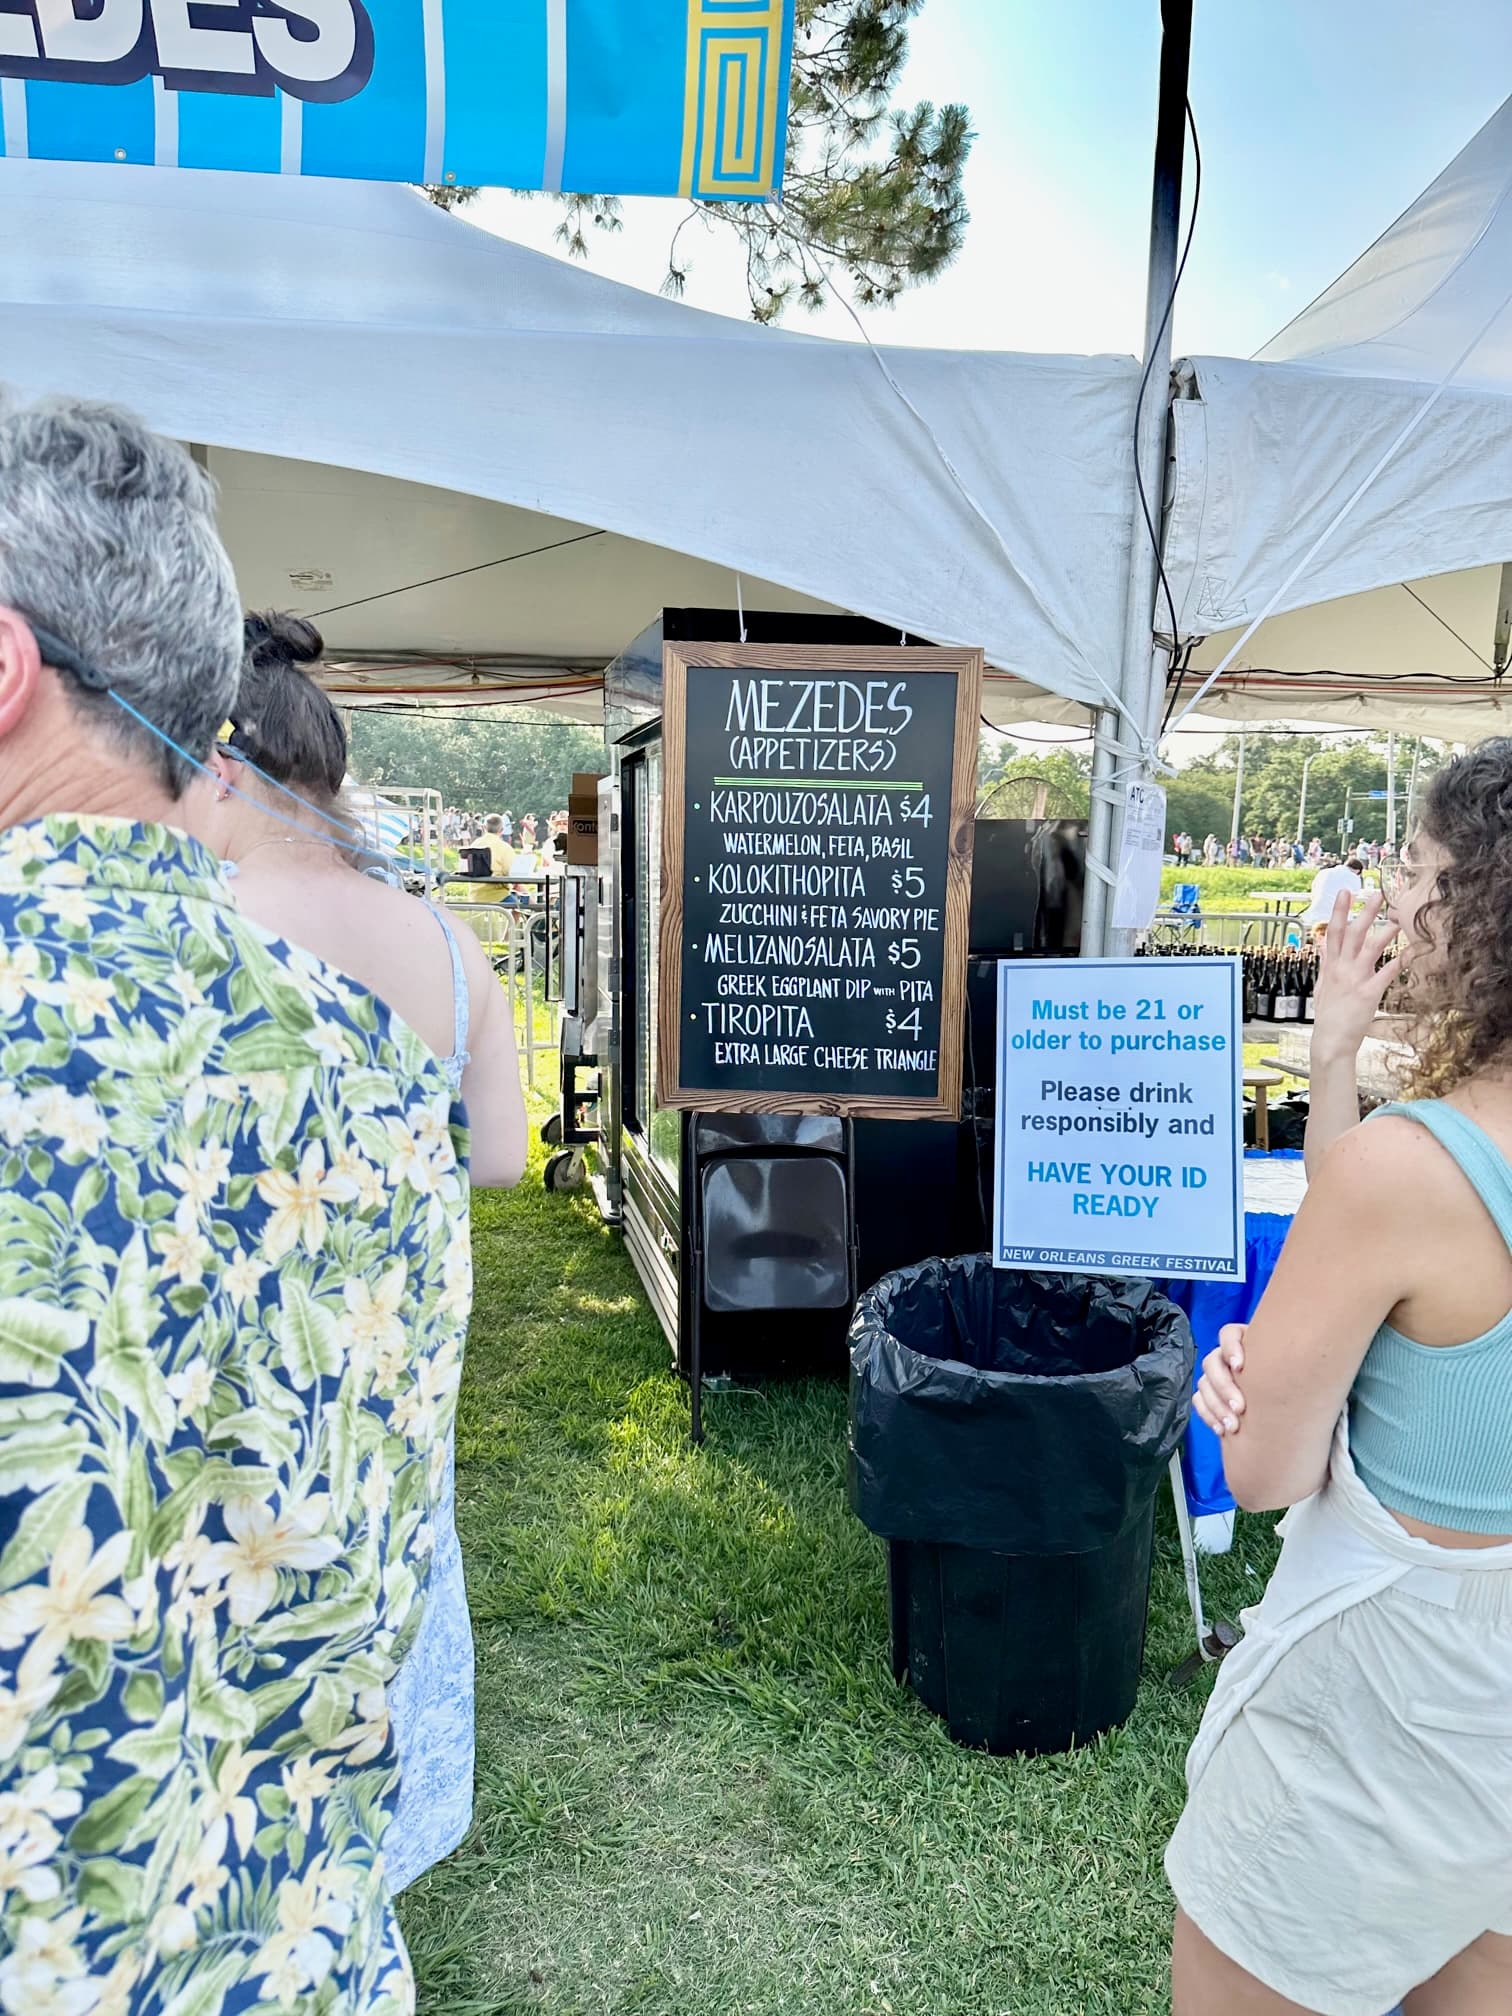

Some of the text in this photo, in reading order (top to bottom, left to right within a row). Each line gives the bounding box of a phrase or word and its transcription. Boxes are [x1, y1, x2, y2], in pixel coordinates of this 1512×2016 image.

[724, 679, 913, 735] MEZEDES
[730, 735, 897, 772] (APPETIZERS)
[710, 791, 933, 828] KARPOUZOSALATA $4
[724, 833, 914, 862] WATERMELON, FETA, BASIL
[708, 864, 926, 898] KOLOKITHOPITA $5
[719, 903, 797, 927] ZUCCHINI
[810, 906, 848, 929] FETA
[852, 907, 912, 930] SAVORY
[914, 909, 939, 931] PIE
[704, 933, 921, 969] MELIZANOSALATA $5
[717, 975, 766, 997] GREEK
[772, 976, 840, 999] EGGPLANT
[846, 979, 872, 1000] DIP
[900, 980, 934, 1002] PITA
[701, 1002, 923, 1041] TIROPITA $4
[1032, 999, 1205, 1021] Must be 21 or
[1011, 1029, 1227, 1055] older to purchase
[715, 1042, 938, 1071] EXTRA LARGE CHEESE TRIANGLE
[1041, 1080, 1194, 1104] Please drink
[1021, 1112, 1215, 1138] responsibly and
[1028, 1161, 1208, 1188] HAVE YOUR ID
[1073, 1193, 1160, 1218] READY
[1003, 1248, 1236, 1273] NEW ORLEANS GREEK FESTIVAL
